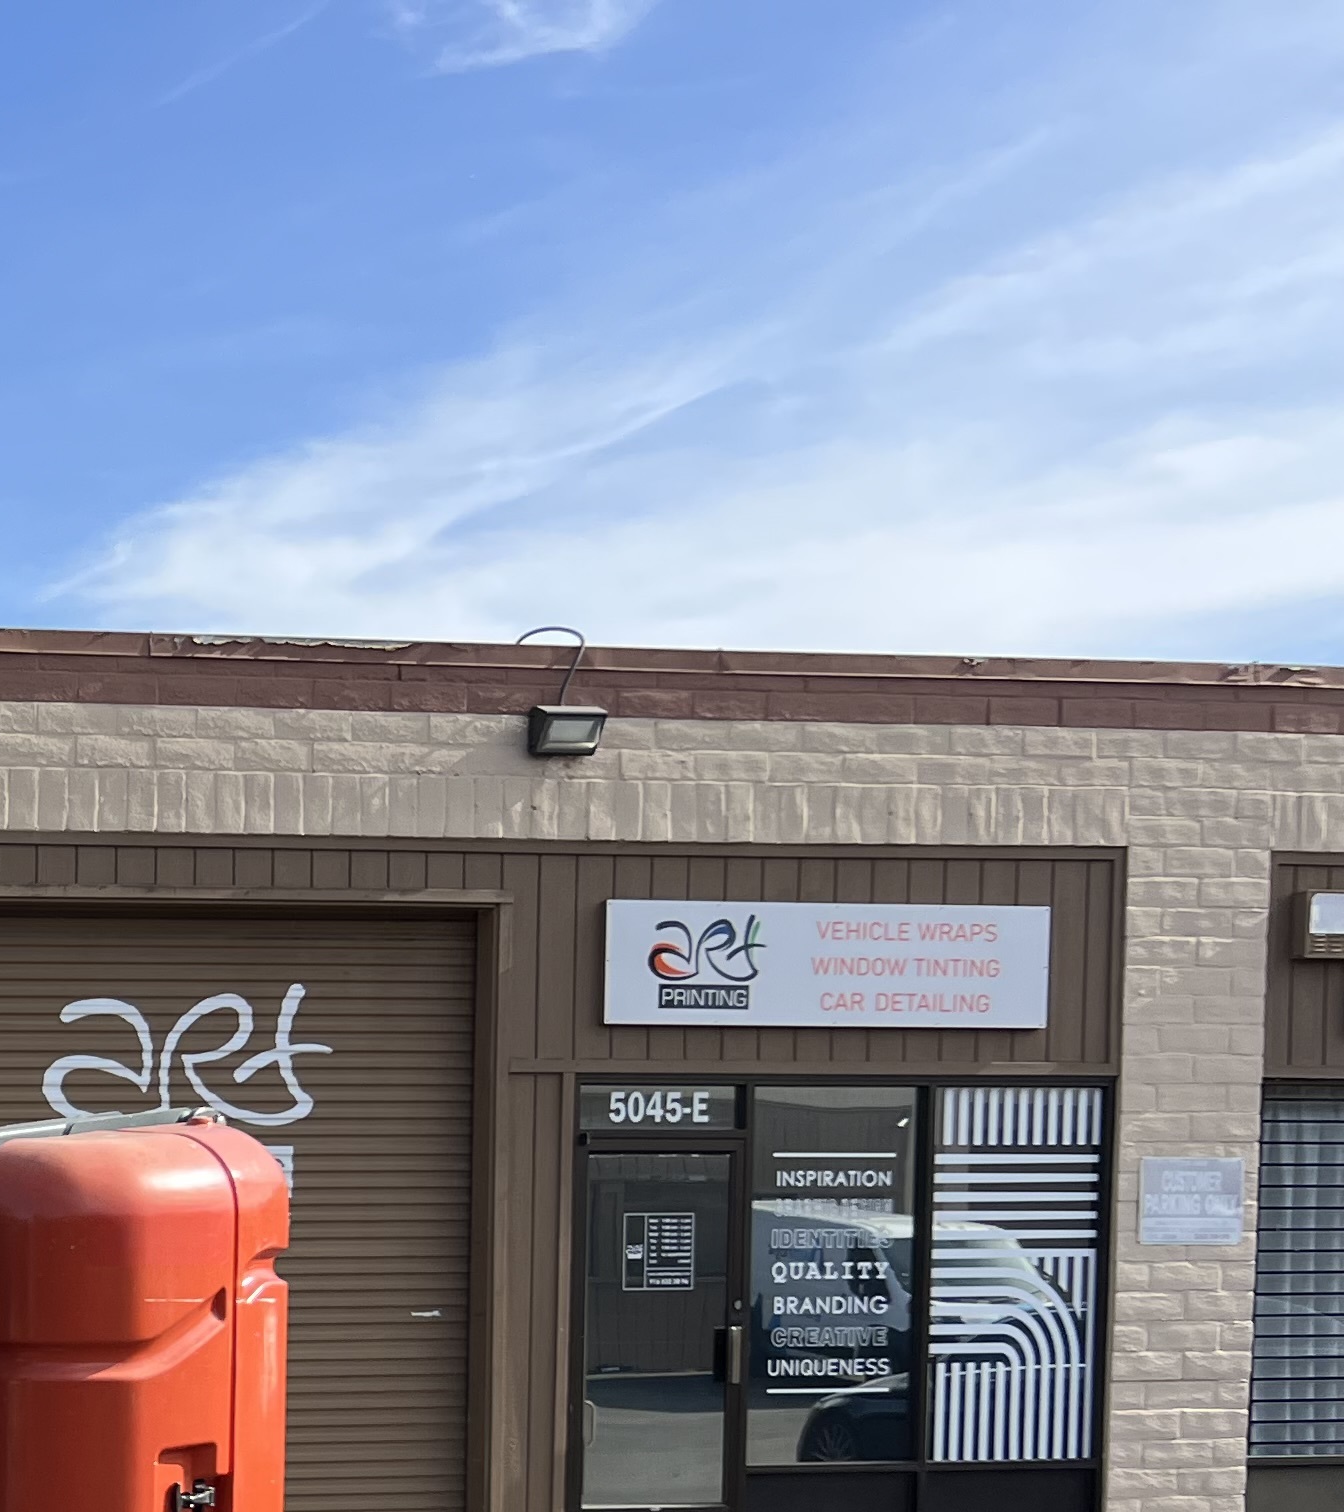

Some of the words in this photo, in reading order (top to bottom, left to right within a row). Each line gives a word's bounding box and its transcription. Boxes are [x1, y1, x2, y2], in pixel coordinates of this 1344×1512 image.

[816, 921, 911, 942] VEHICLE
[918, 923, 999, 943] WRAPS
[811, 957, 908, 977] WINDOW
[913, 958, 1001, 978] TINTING
[661, 989, 748, 1007] PRINTING
[820, 992, 865, 1012] CAR
[875, 993, 991, 1013] DETAILING
[609, 1091, 710, 1123] 5045-E
[776, 1170, 893, 1187] INSPIRATION
[771, 1229, 890, 1249] IDENTITIES
[771, 1262, 889, 1283] QUALITY
[773, 1296, 889, 1314] BRANDING
[771, 1327, 888, 1347] CREATIVE
[767, 1359, 890, 1376] UNIQUENESS
